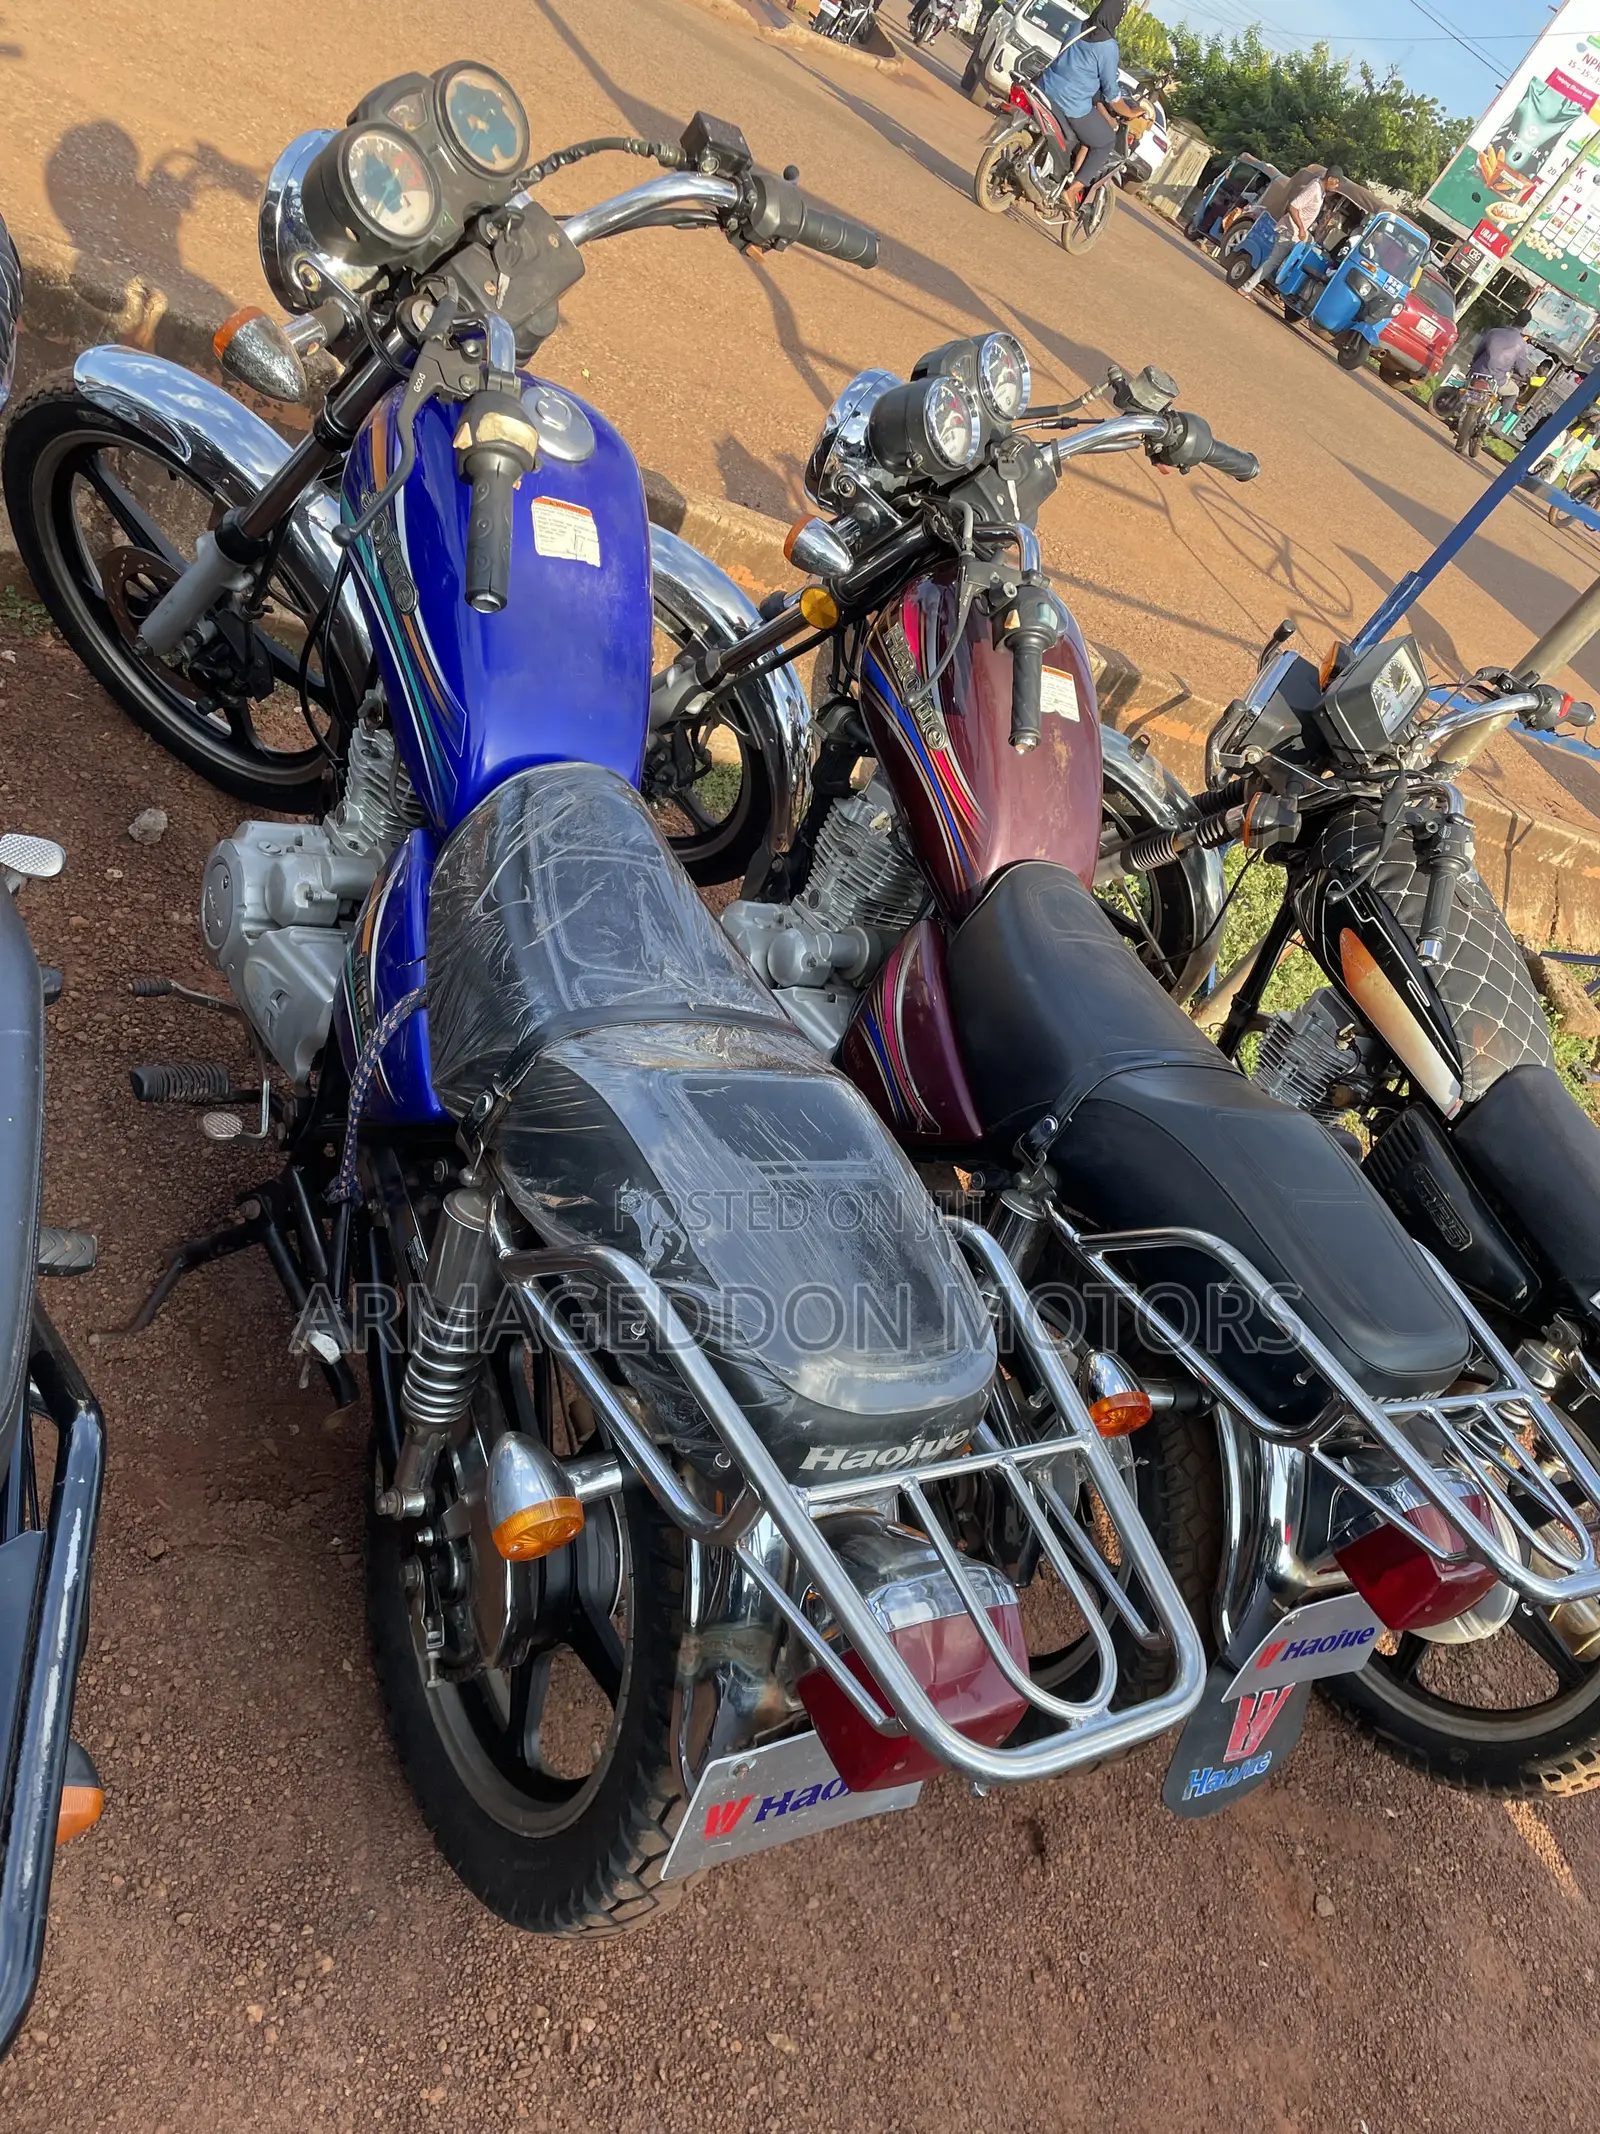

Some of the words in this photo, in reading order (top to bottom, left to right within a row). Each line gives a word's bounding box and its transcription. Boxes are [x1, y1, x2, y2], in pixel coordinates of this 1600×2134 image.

[798, 1429, 970, 1471] Haojue
[1280, 1627, 1375, 1663] Haojue
[1182, 1750, 1273, 1801] Haojue
[753, 1776, 852, 1824] Hao
